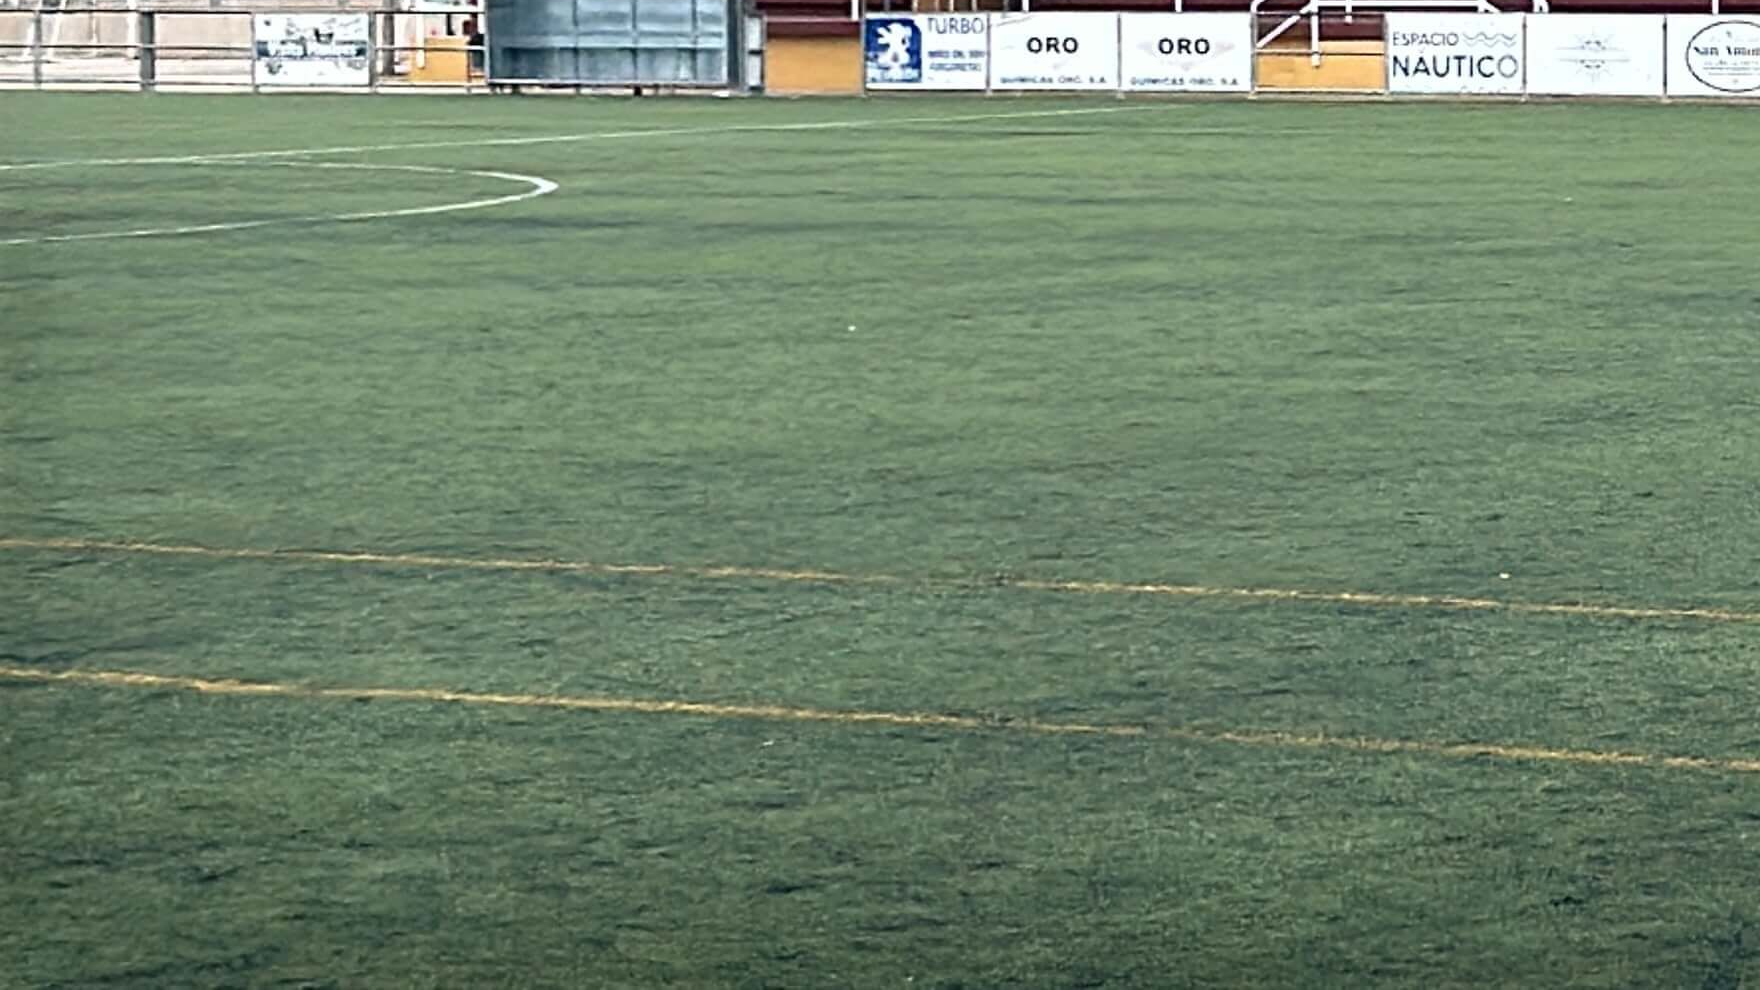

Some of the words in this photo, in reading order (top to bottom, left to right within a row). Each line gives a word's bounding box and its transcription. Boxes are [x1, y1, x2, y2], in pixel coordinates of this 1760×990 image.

[927, 17, 985, 35] TURBO
[1026, 36, 1079, 54] ORO
[1158, 37, 1210, 55] ORO
[1393, 31, 1459, 46] ESPACIO
